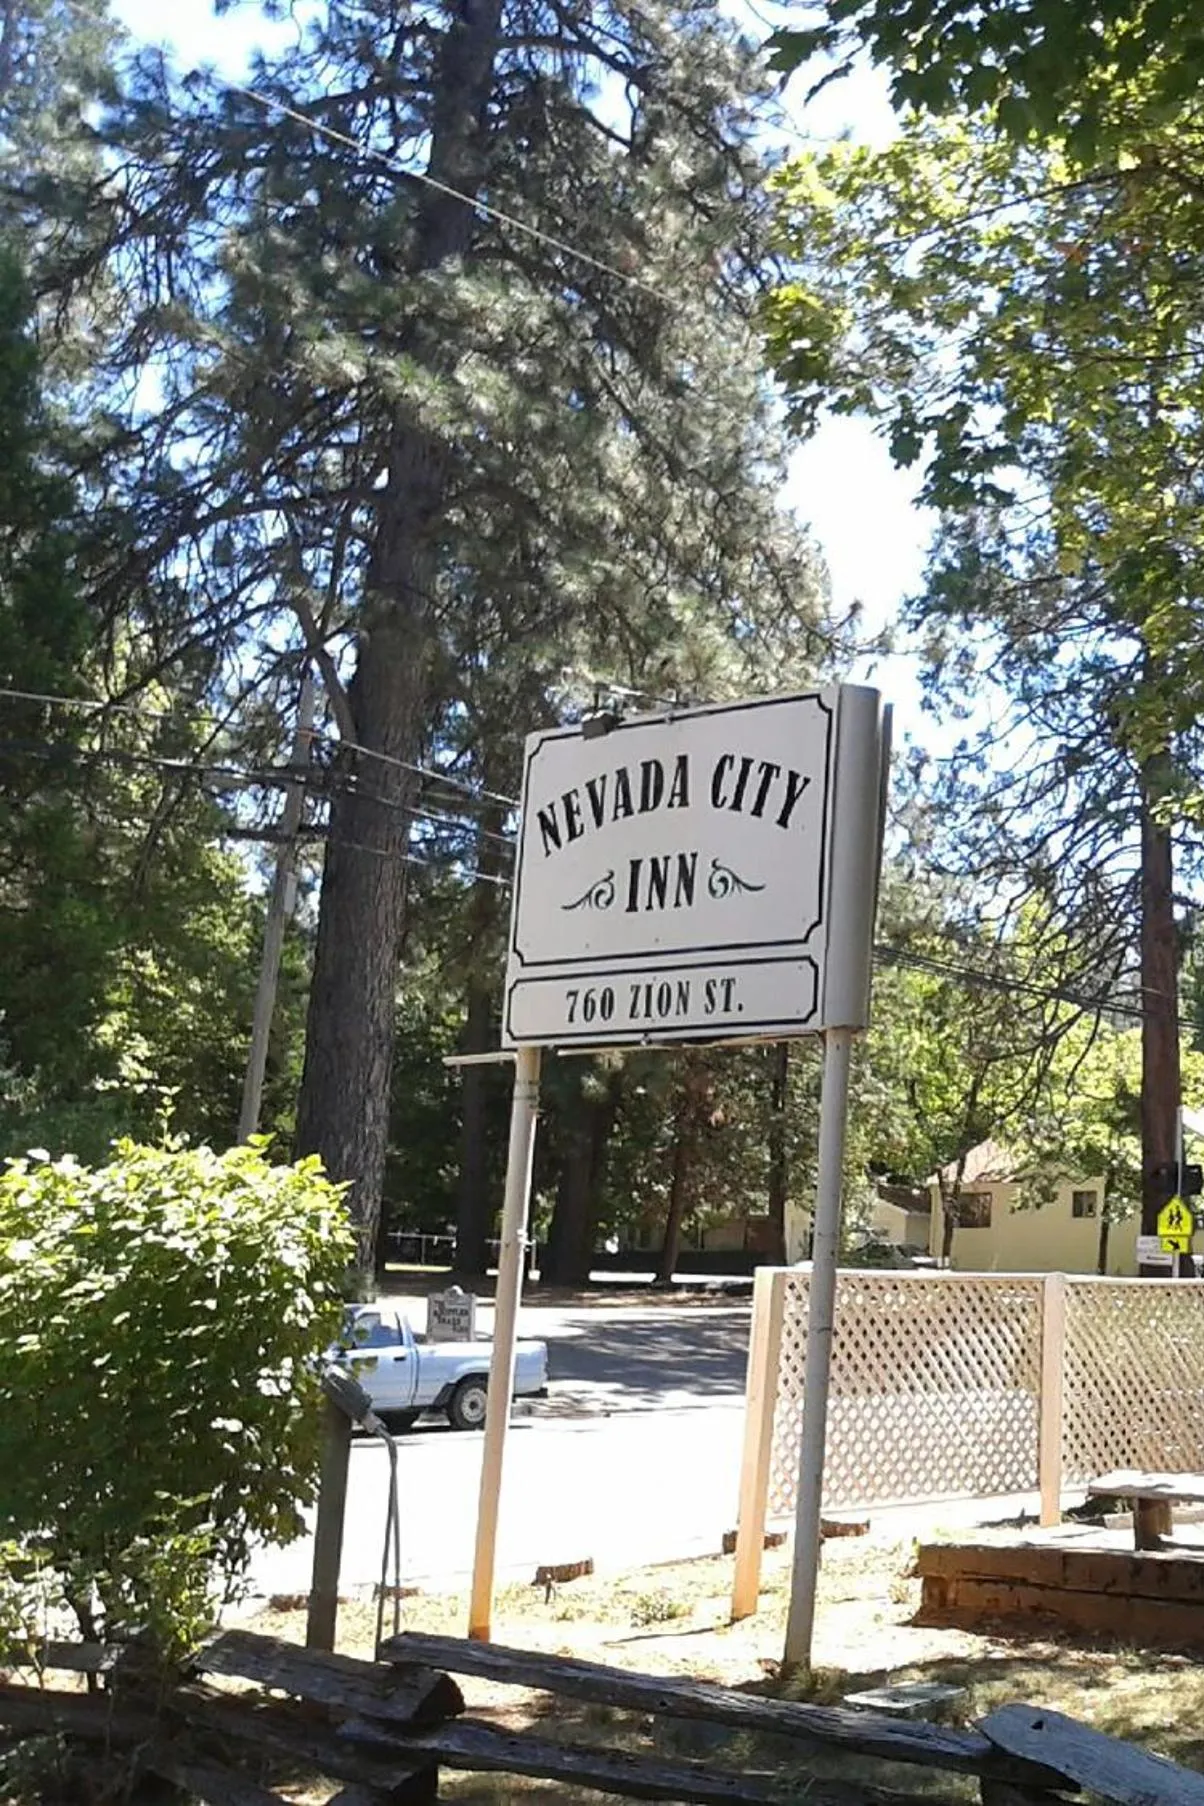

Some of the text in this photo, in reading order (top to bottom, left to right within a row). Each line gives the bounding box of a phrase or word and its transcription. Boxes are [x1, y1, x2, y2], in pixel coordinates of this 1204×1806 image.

[537, 753, 811, 857] NEVADA CITY
[625, 852, 699, 913] INN
[566, 977, 744, 1024] 760 ZION ST.
